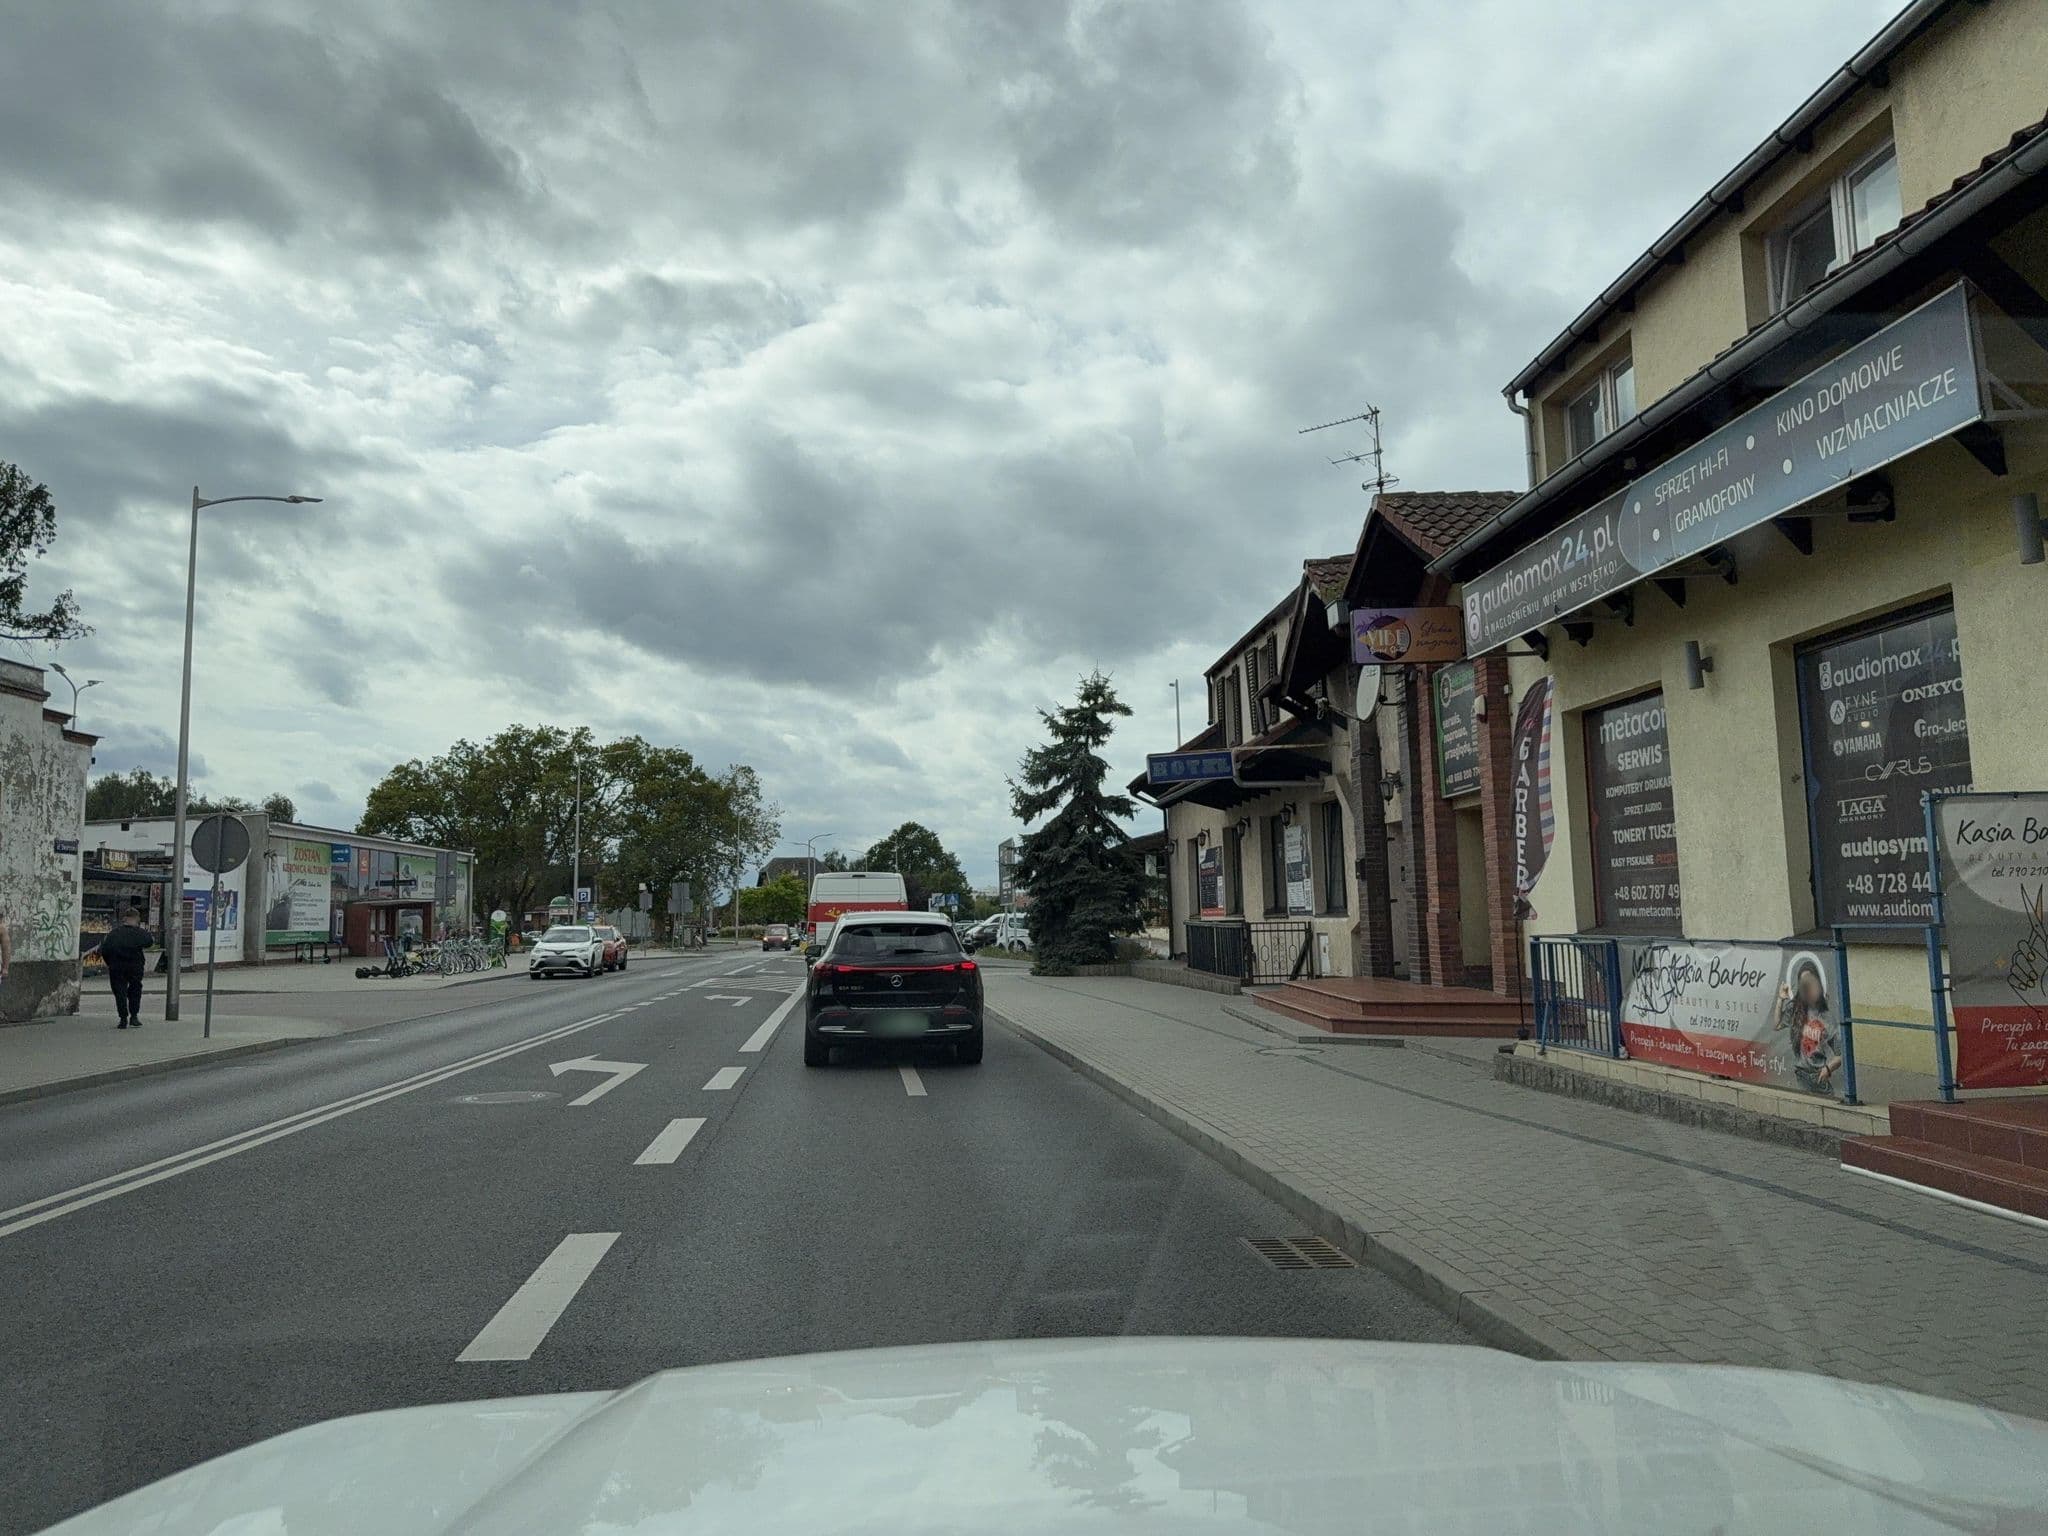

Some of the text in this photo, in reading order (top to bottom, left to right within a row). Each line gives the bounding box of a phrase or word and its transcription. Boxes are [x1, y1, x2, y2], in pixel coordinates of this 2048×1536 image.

[1776, 345, 1904, 436] KINO DOMOWE
[1816, 368, 1958, 460] WZMACNIACZE
[1654, 447, 1728, 505] SPRZĘT HI-FI
[1675, 473, 1756, 533] GRAMOFONY
[1482, 514, 1613, 614] audiomax24.pl
[1542, 588, 1568, 608] WIEMY
[1902, 677, 1964, 703] ONKYO
[1844, 732, 1882, 754] YAMAHA
[1617, 744, 1663, 771] SERWIS
[1865, 756, 1932, 781] CYRUS
[1605, 781, 1644, 798] KOMPUTERY
[1837, 795, 1887, 816] TAGA
[1612, 826, 1647, 844] TONERY
[1957, 820, 2016, 845] Kasia
[1611, 857, 1626, 867] KASY
[1626, 854, 1654, 866] FISKALNE
[2009, 866, 2027, 877] 790
[1614, 883, 1679, 900] +48 602 787 49
[1846, 871, 1931, 894] +48 728 44
[1708, 956, 1766, 989] Barber
[1727, 1002, 1759, 1014] STYLE
[1981, 1018, 2033, 1037] Precyzja
[2005, 1037, 2018, 1052] Tu
